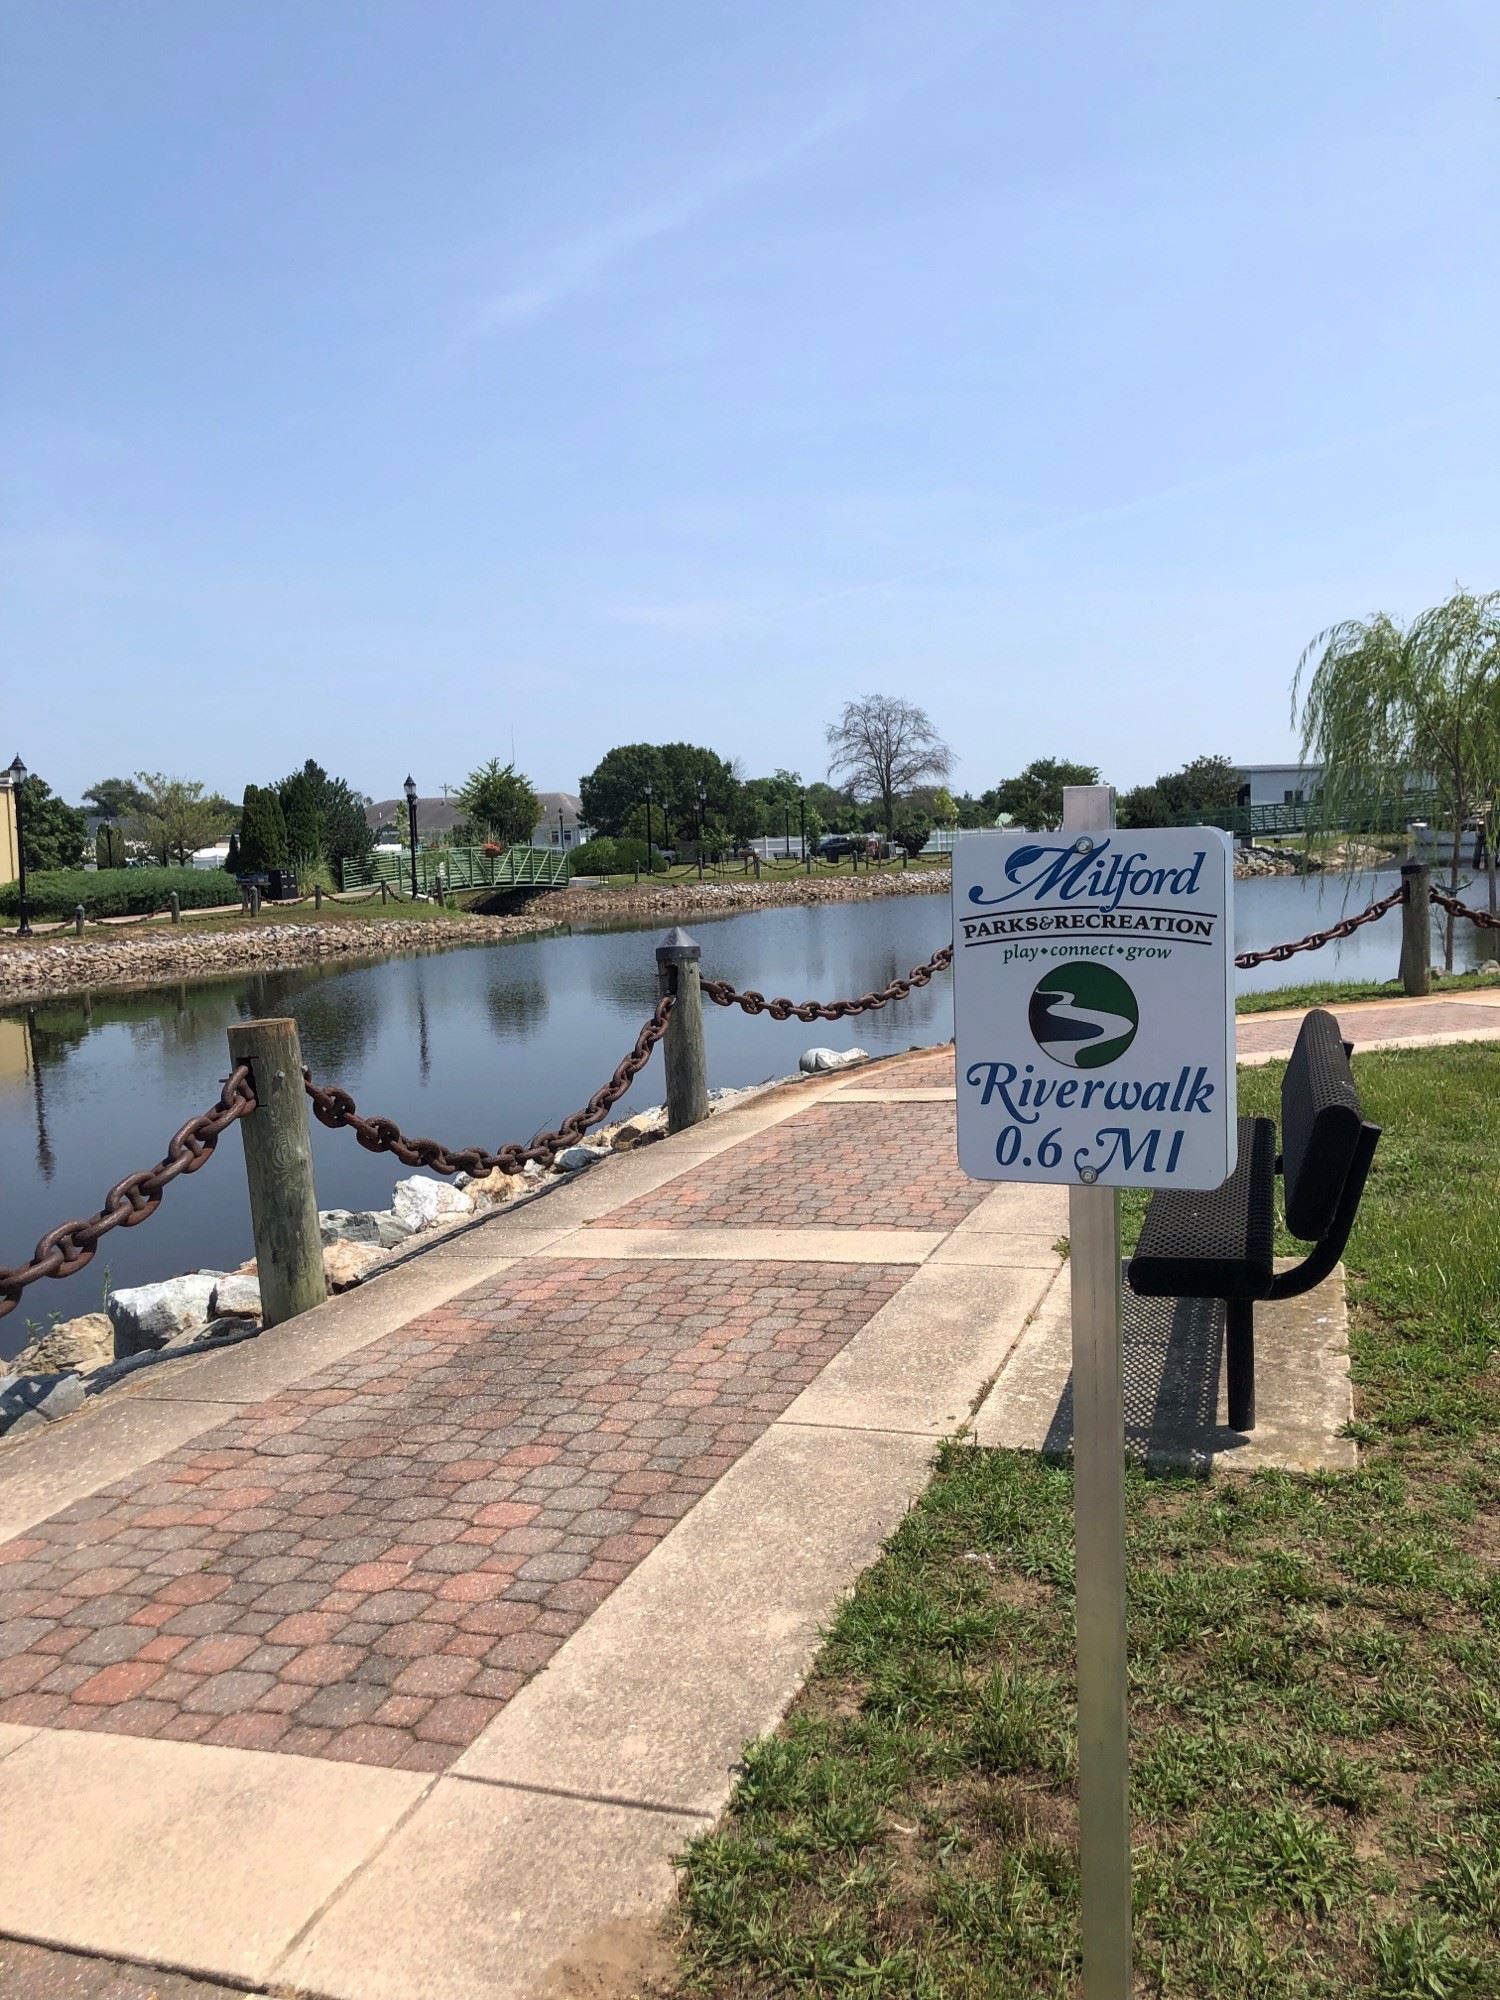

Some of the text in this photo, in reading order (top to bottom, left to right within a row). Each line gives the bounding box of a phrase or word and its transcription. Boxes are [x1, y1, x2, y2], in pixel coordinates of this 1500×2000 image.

[968, 838, 1206, 912] Milford
[1003, 944, 1172, 964] play connect grow
[966, 1062, 1215, 1124] Riverwalk
[996, 1125, 1185, 1174] 0.6 MI
